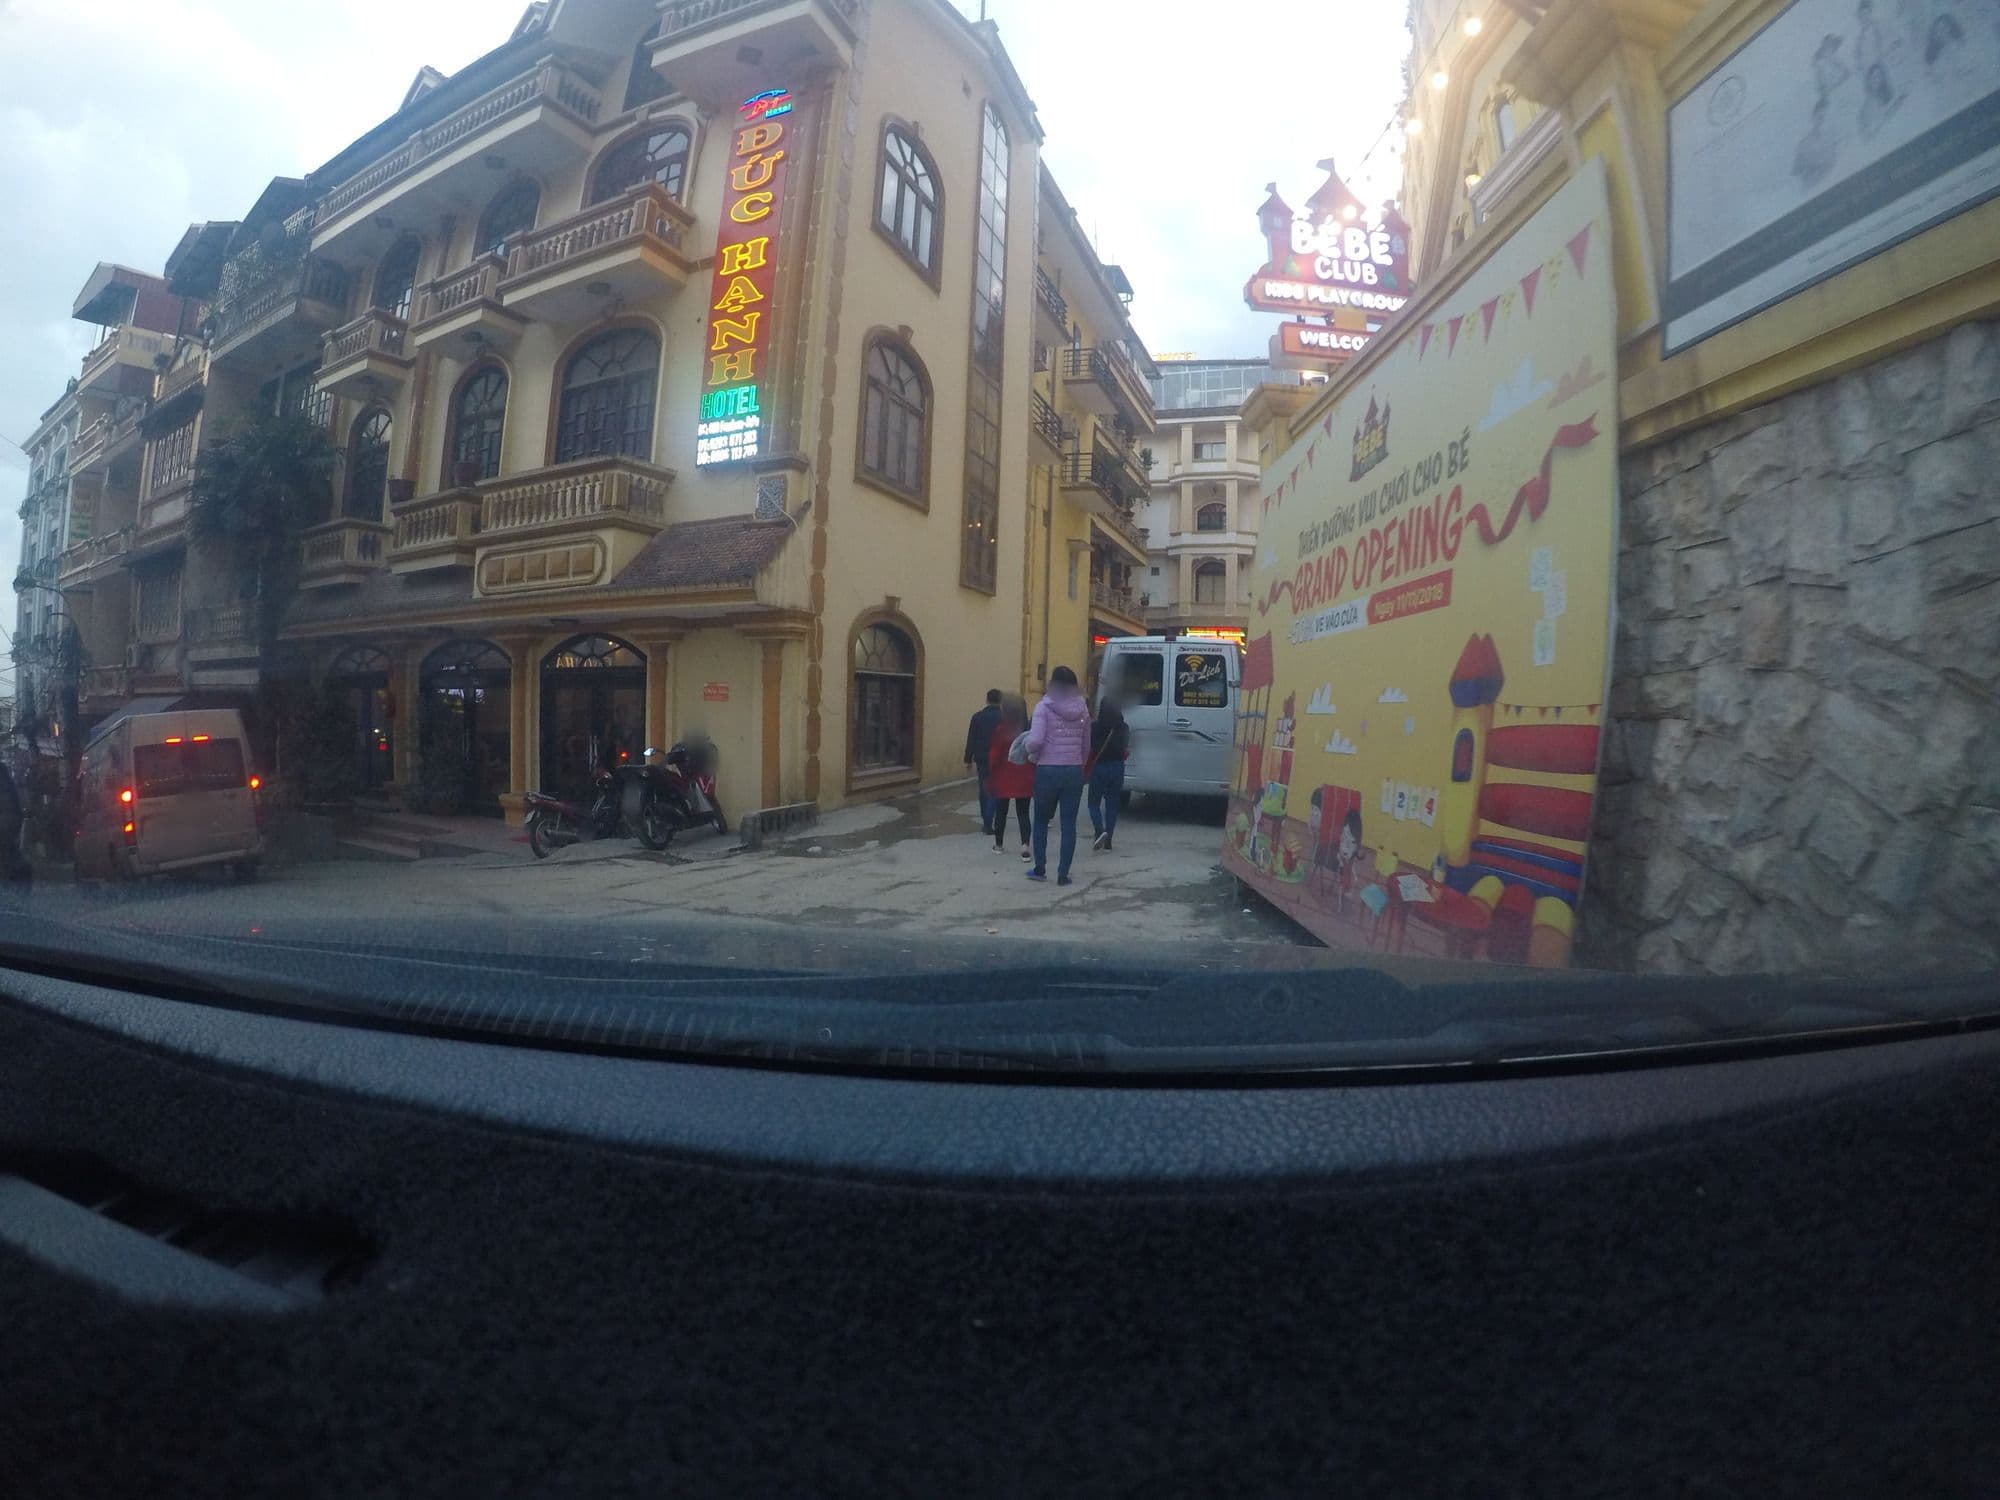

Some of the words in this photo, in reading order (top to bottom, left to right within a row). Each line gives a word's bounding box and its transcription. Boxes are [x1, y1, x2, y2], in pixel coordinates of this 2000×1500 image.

[730, 122, 785, 223] ĐỨC
[707, 236, 769, 386] HẠNH
[1314, 256, 1379, 286] CLUB
[1300, 330, 1371, 351] WELCO
[700, 384, 760, 420] HOTEL
[1358, 489, 1377, 527] VUI
[1412, 450, 1443, 497] CHO
[1446, 424, 1470, 480] BÉ
[1292, 544, 1348, 615] GRAND
[1352, 484, 1464, 591] OPENING
